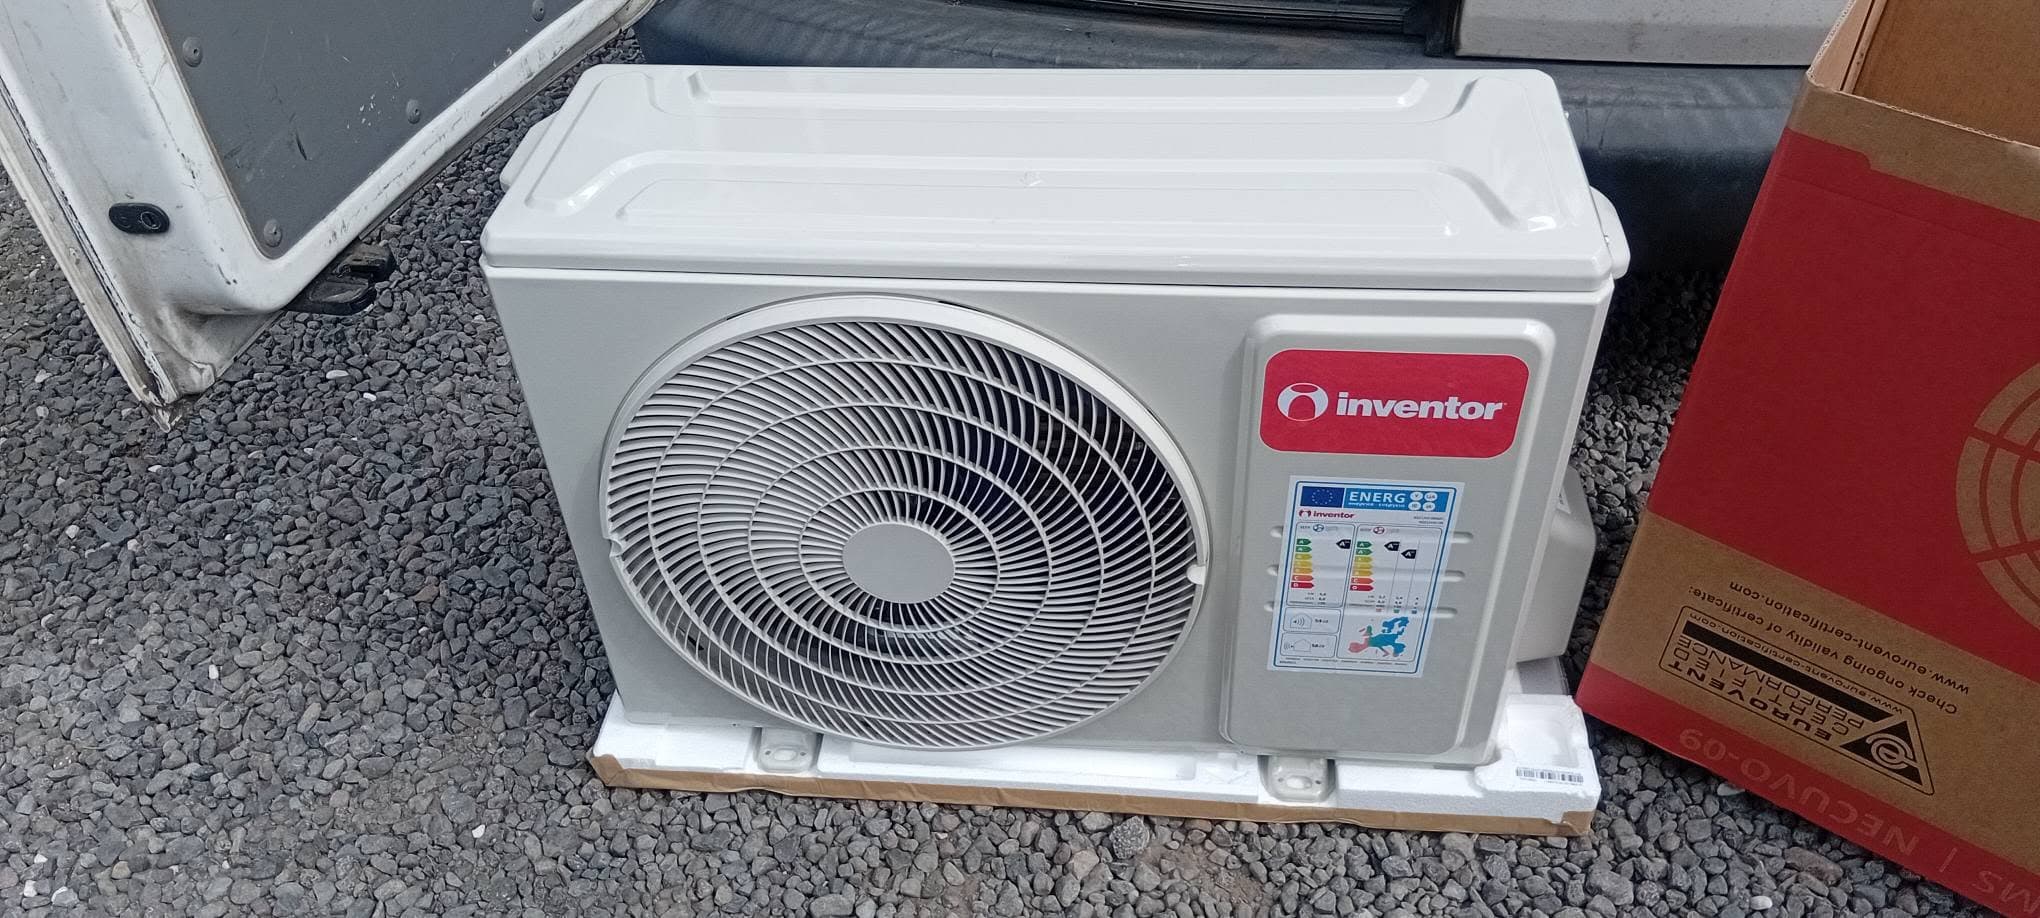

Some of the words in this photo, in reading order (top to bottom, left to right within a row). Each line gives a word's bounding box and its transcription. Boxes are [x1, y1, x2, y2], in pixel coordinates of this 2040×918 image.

[1336, 391, 1502, 420] inventor
[1313, 510, 1355, 519] inventor
[1349, 491, 1406, 503] ENERG
[1688, 585, 1764, 625] certificate:
[1729, 581, 1970, 694] www.eurovent-certification.com
[1765, 618, 1782, 635] of
[1786, 628, 1838, 659] validity
[1677, 635, 1865, 729] PERFORMANCE
[1842, 650, 1905, 690] ongoing
[1668, 661, 1832, 741] EUROVENT
[1673, 647, 1849, 736] CERTIFIED
[1908, 684, 1958, 715] Check
[1679, 728, 1920, 856] NECUVO-09
